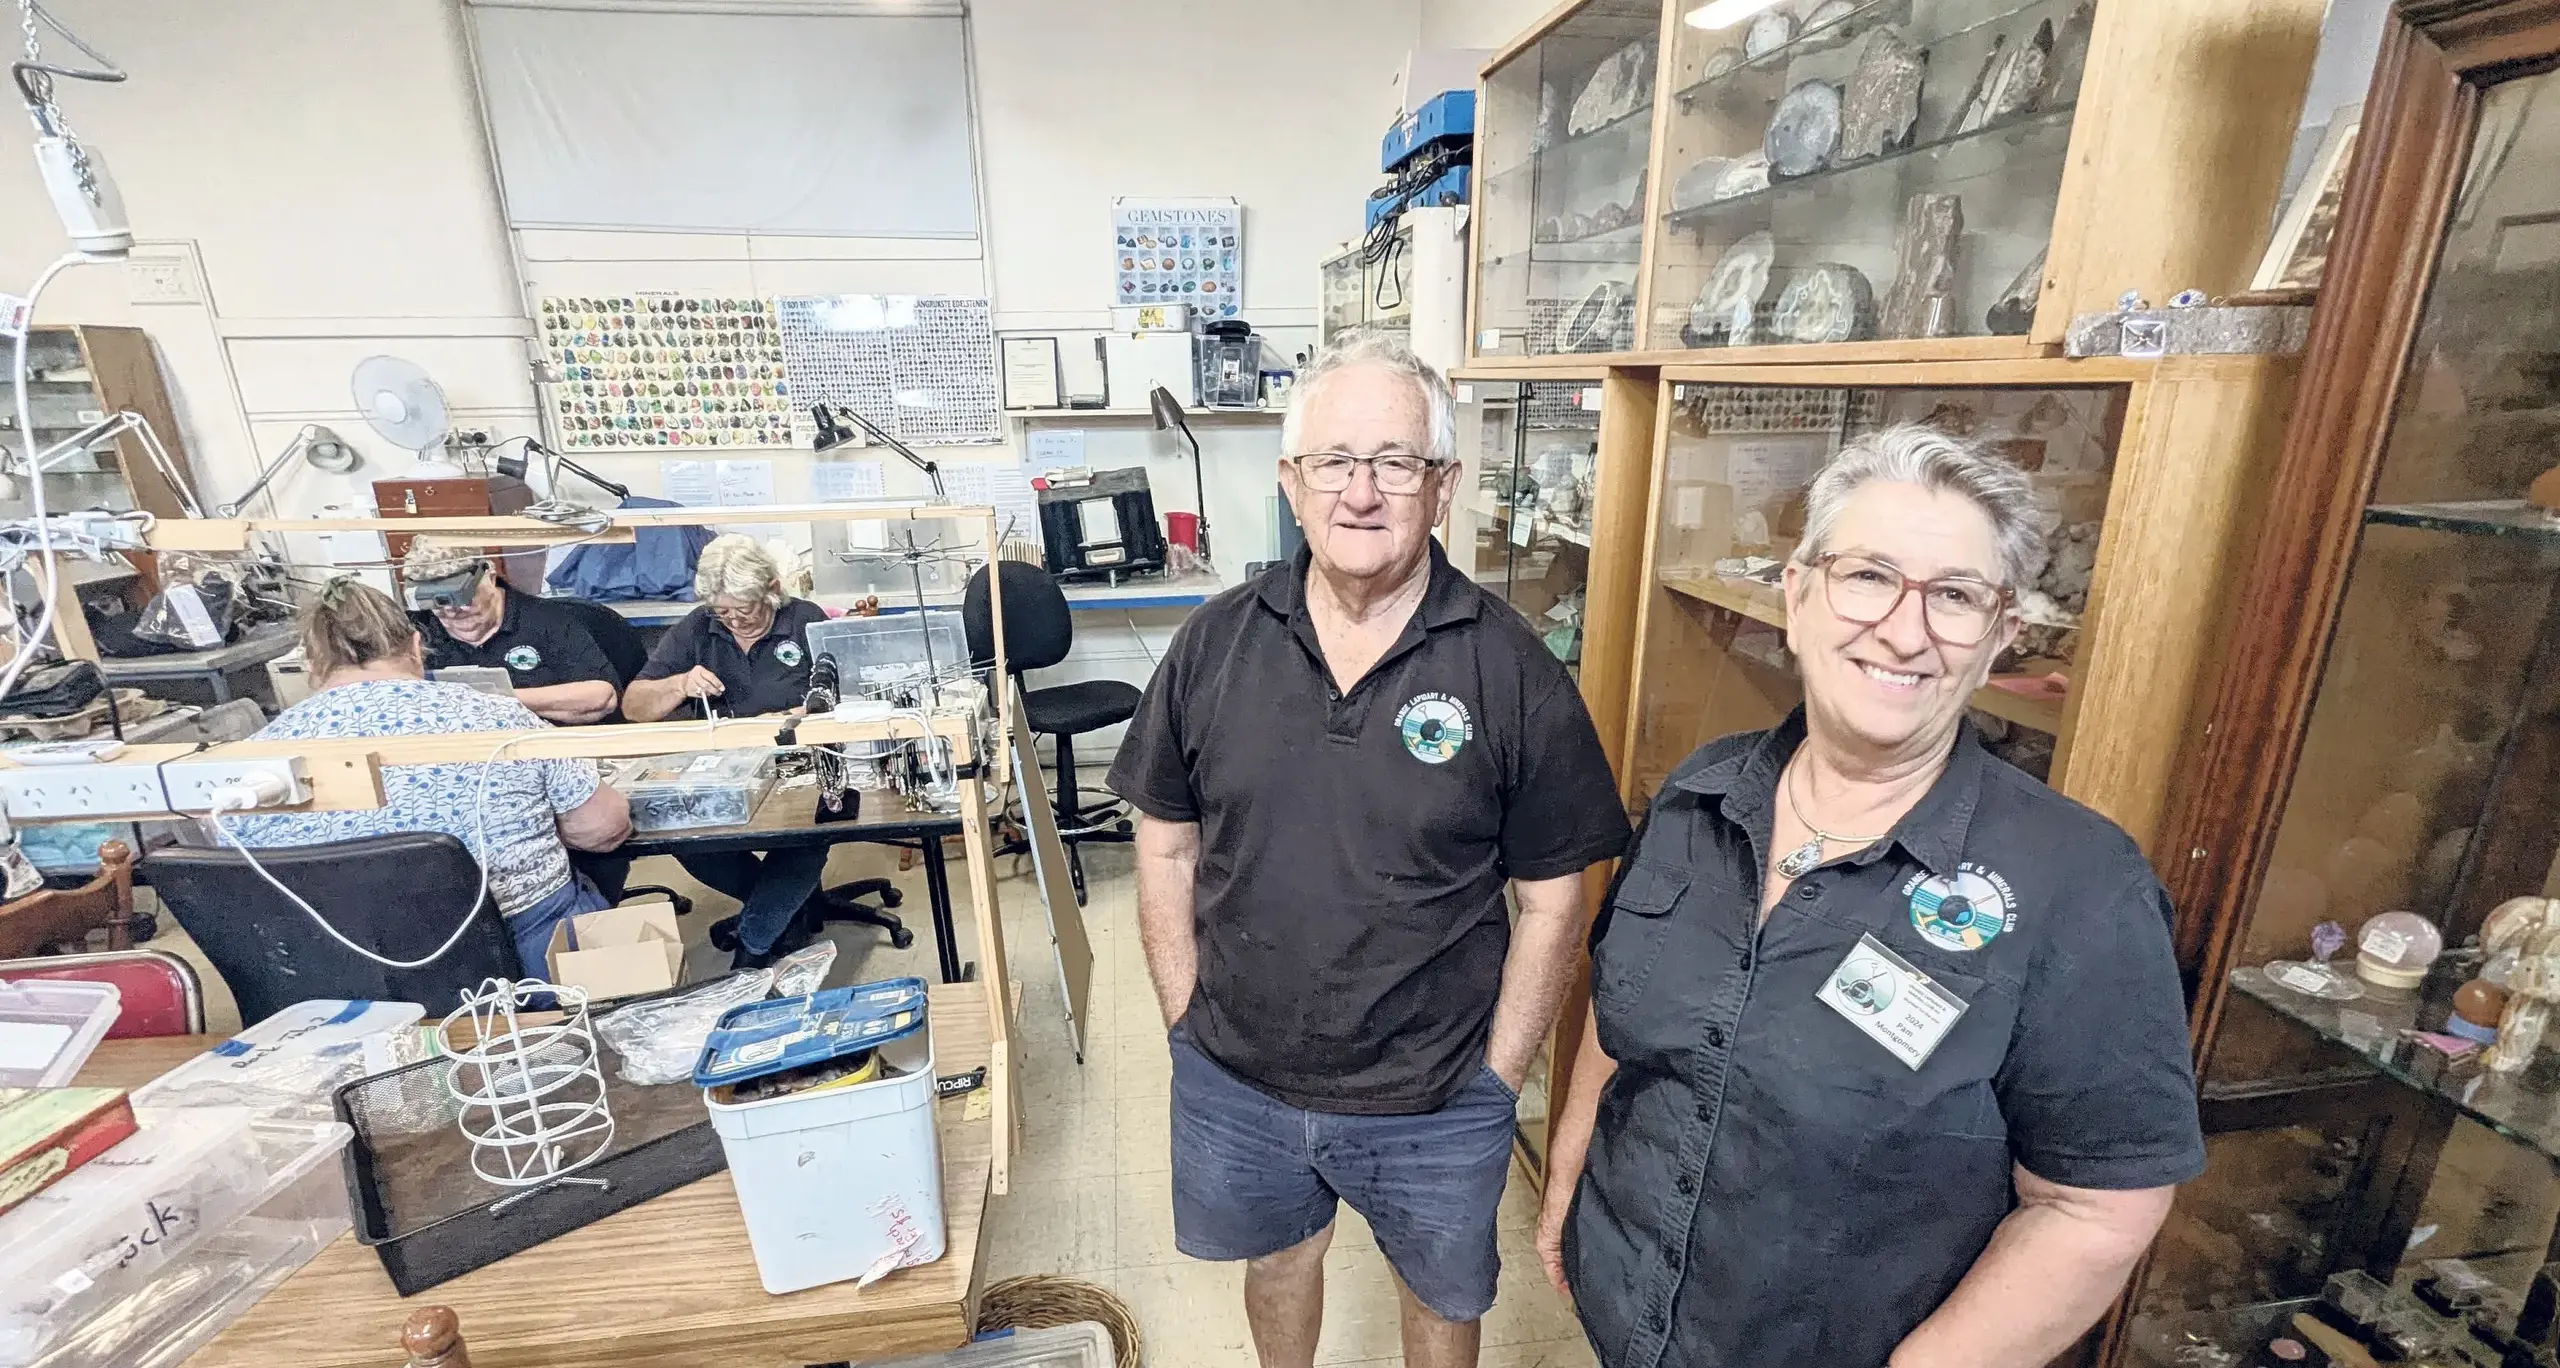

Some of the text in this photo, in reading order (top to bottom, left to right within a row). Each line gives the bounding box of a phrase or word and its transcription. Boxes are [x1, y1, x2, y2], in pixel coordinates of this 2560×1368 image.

[1127, 209, 1227, 223] GEMSTONES
[1441, 692, 1447, 700] &
[1976, 865, 1986, 875] &
[1987, 871, 2017, 909] MINERALS
[2002, 913, 2018, 933] CLUB
[1896, 1022, 1914, 1037] Pam
[1905, 1013, 1924, 1030] 2024
[1874, 1020, 1921, 1058] Montgomery
[115, 1201, 179, 1269] ock
